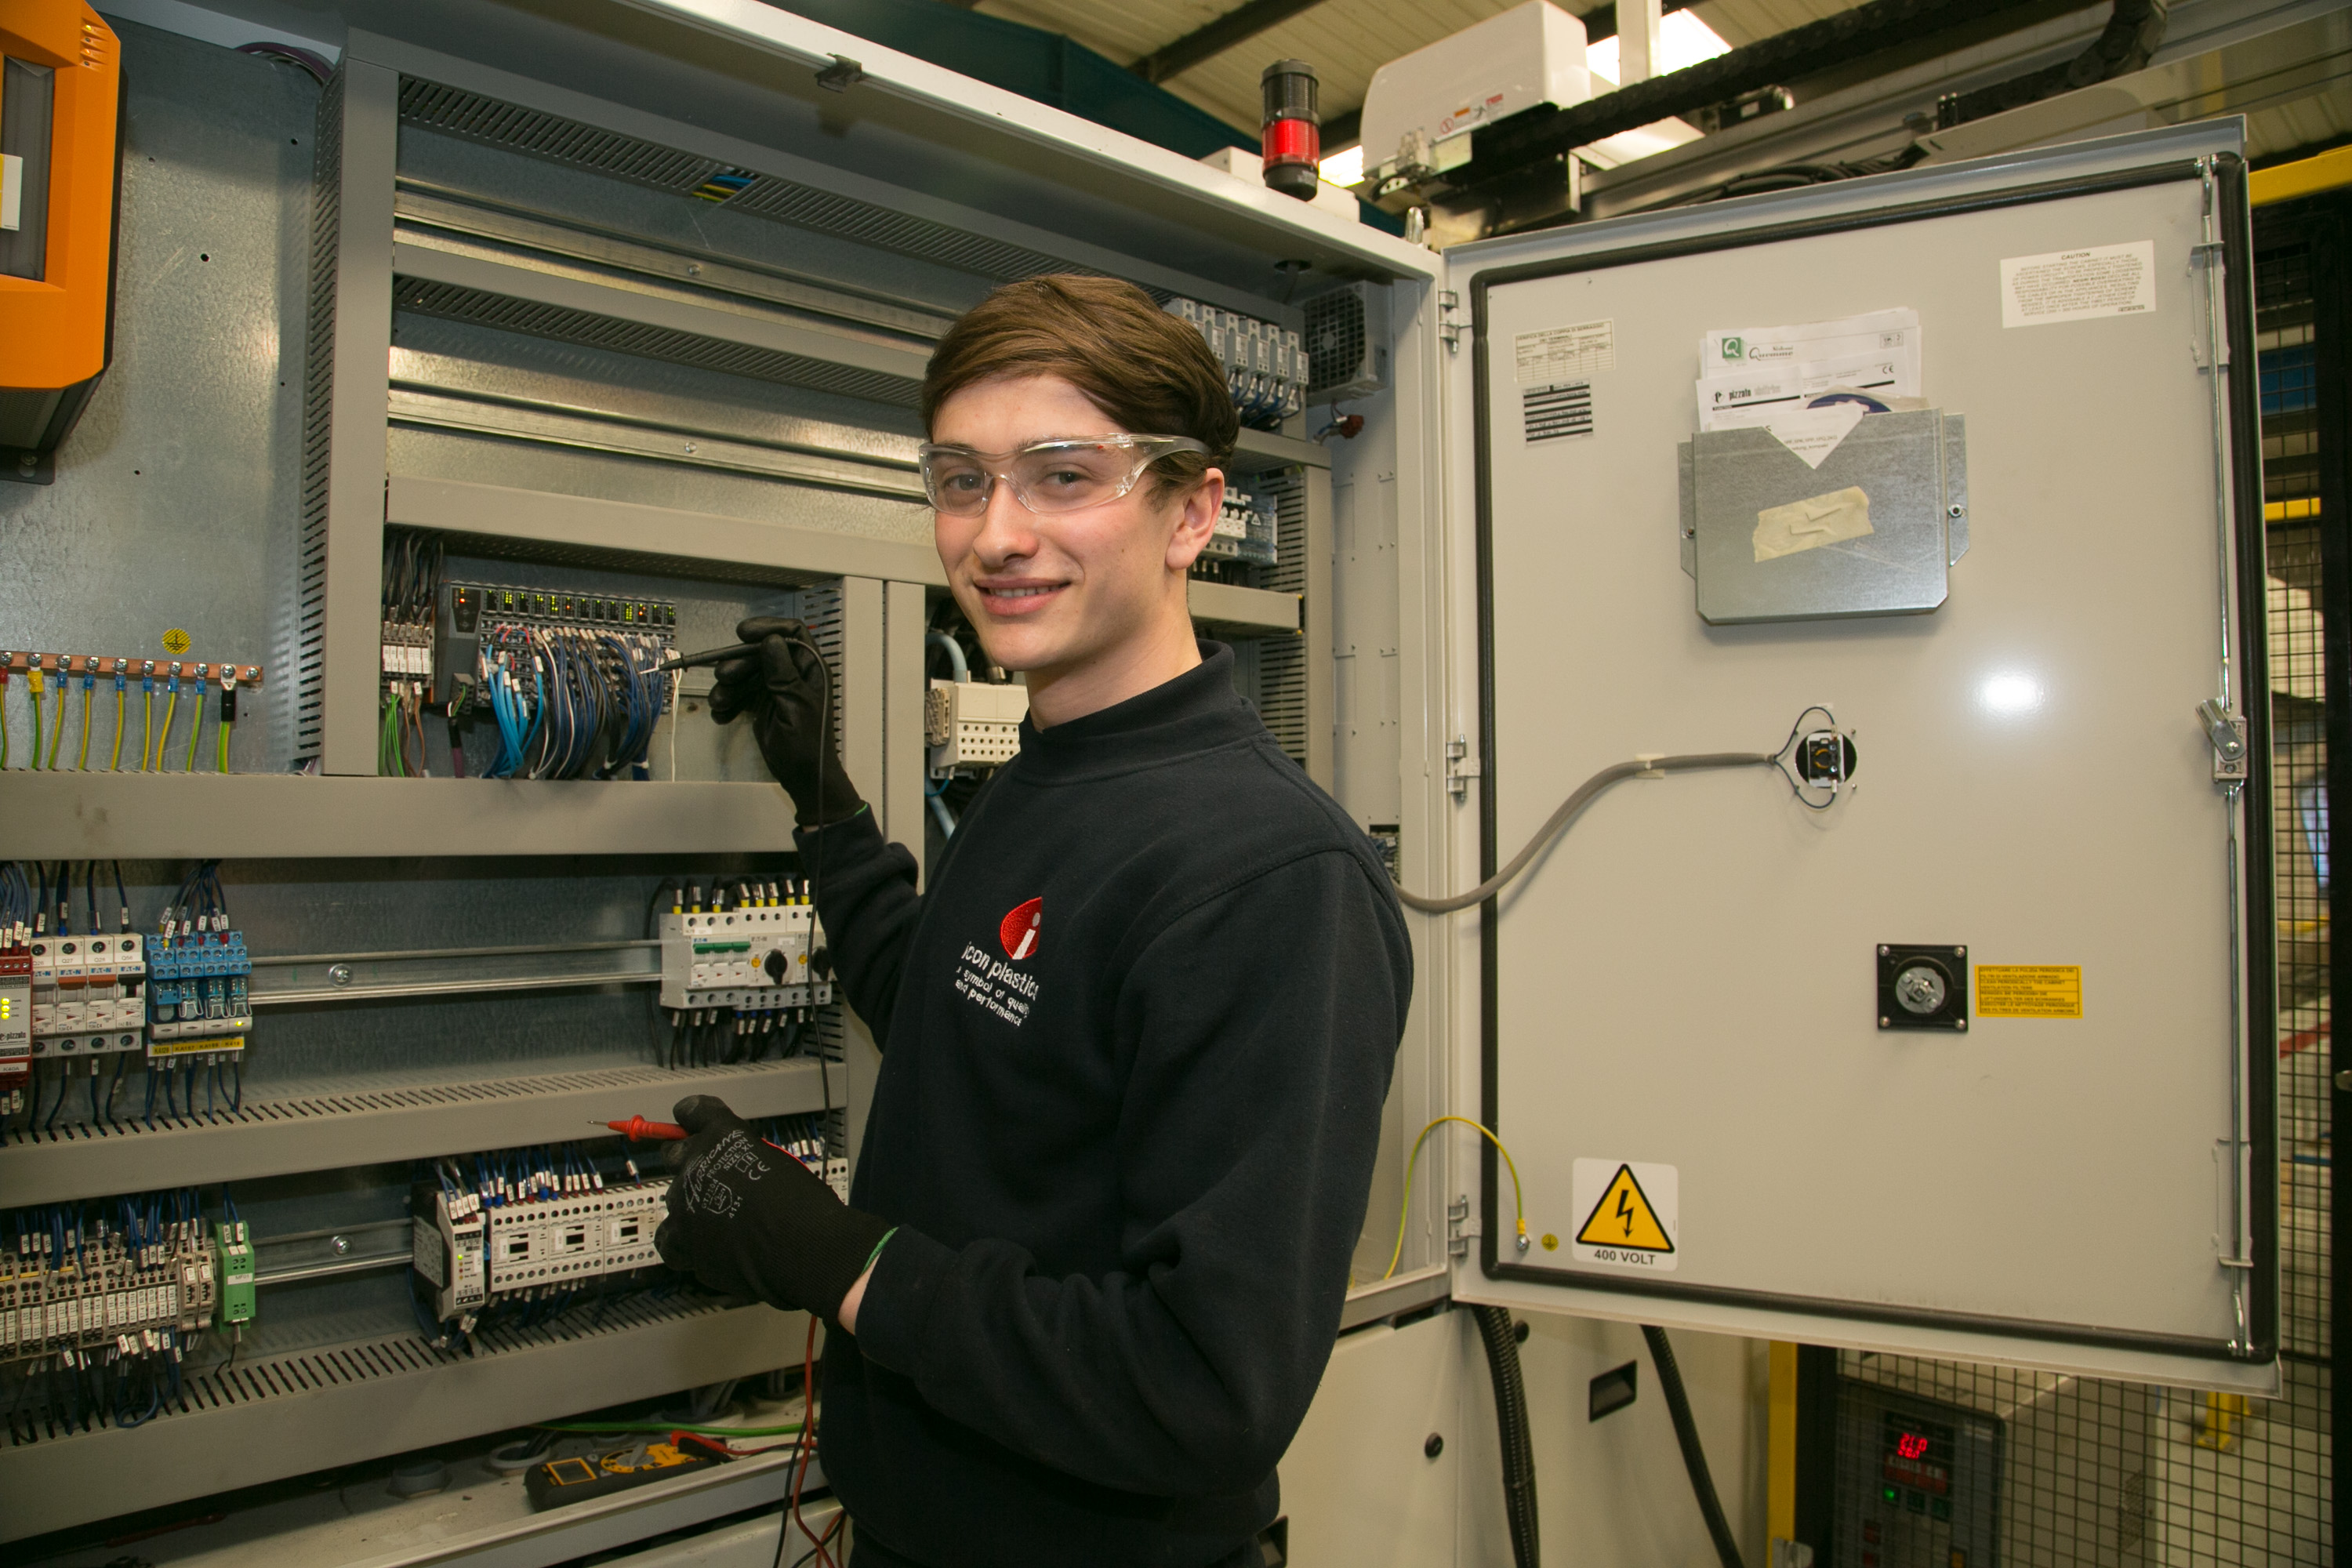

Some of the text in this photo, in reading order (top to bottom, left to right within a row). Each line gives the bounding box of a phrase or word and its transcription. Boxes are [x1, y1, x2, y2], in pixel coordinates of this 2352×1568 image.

[1730, 388, 1751, 401] pizzato
[961, 941, 990, 970] icon
[964, 969, 993, 993] symbol
[995, 988, 1005, 1000] of
[955, 978, 1022, 1027] and performance
[706, 1137, 748, 1178] PROTECTION
[723, 1143, 754, 1171] SIZE: XL
[1595, 1249, 1656, 1265] 400 VOLT
